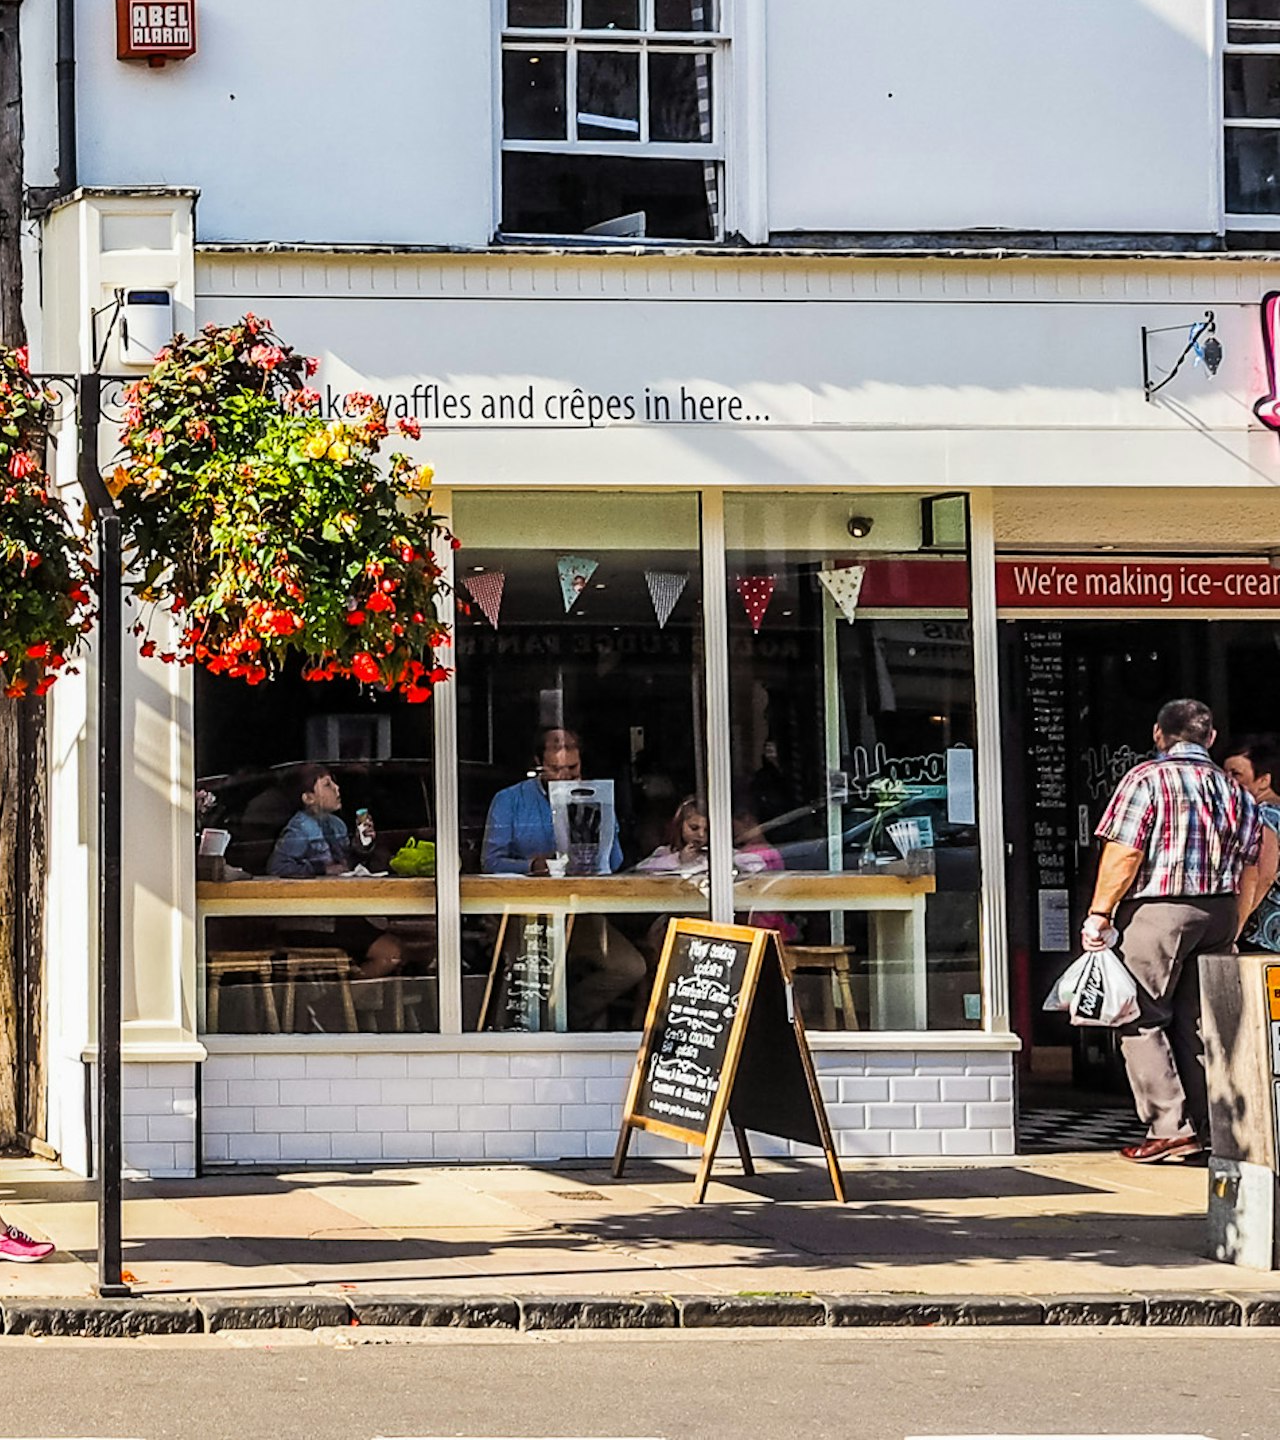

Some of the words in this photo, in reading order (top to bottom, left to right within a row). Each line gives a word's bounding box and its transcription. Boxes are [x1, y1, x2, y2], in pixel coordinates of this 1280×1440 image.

[133, 5, 189, 27] ABEL
[133, 27, 189, 44] ALARM
[482, 385, 534, 419] and
[544, 388, 636, 427] crêpes
[645, 387, 670, 421] in
[681, 386, 771, 422] here...
[1014, 566, 1078, 596] We're
[1085, 565, 1173, 603] making
[851, 741, 950, 801] Hoora
